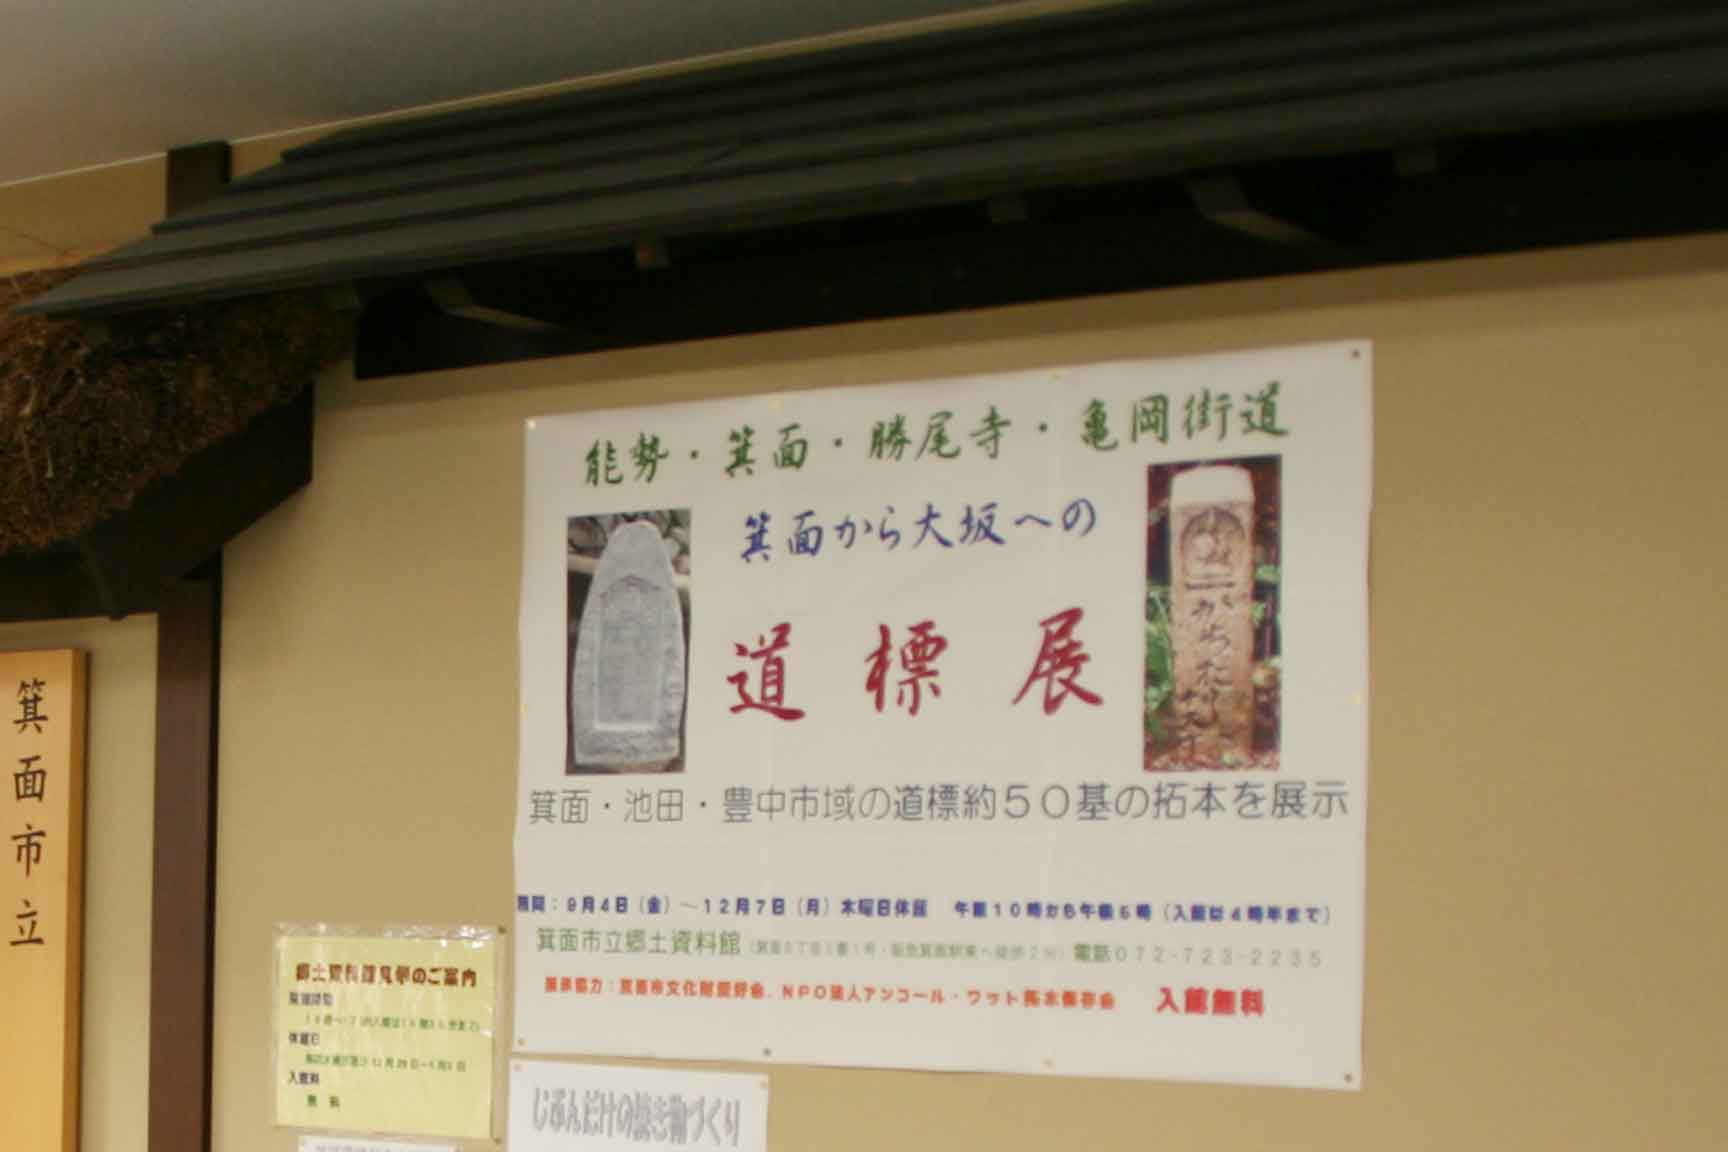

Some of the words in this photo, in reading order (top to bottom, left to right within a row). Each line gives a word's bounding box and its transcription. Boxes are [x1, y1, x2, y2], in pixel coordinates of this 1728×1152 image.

[740, 496, 1098, 566] 箕面から大坂への
[726, 606, 1105, 723] 道標展
[9, 677, 50, 948] 箕面市立
[536, 926, 742, 957] 箕面市立郷土資料館
[1156, 986, 1265, 1017] 入館無料
